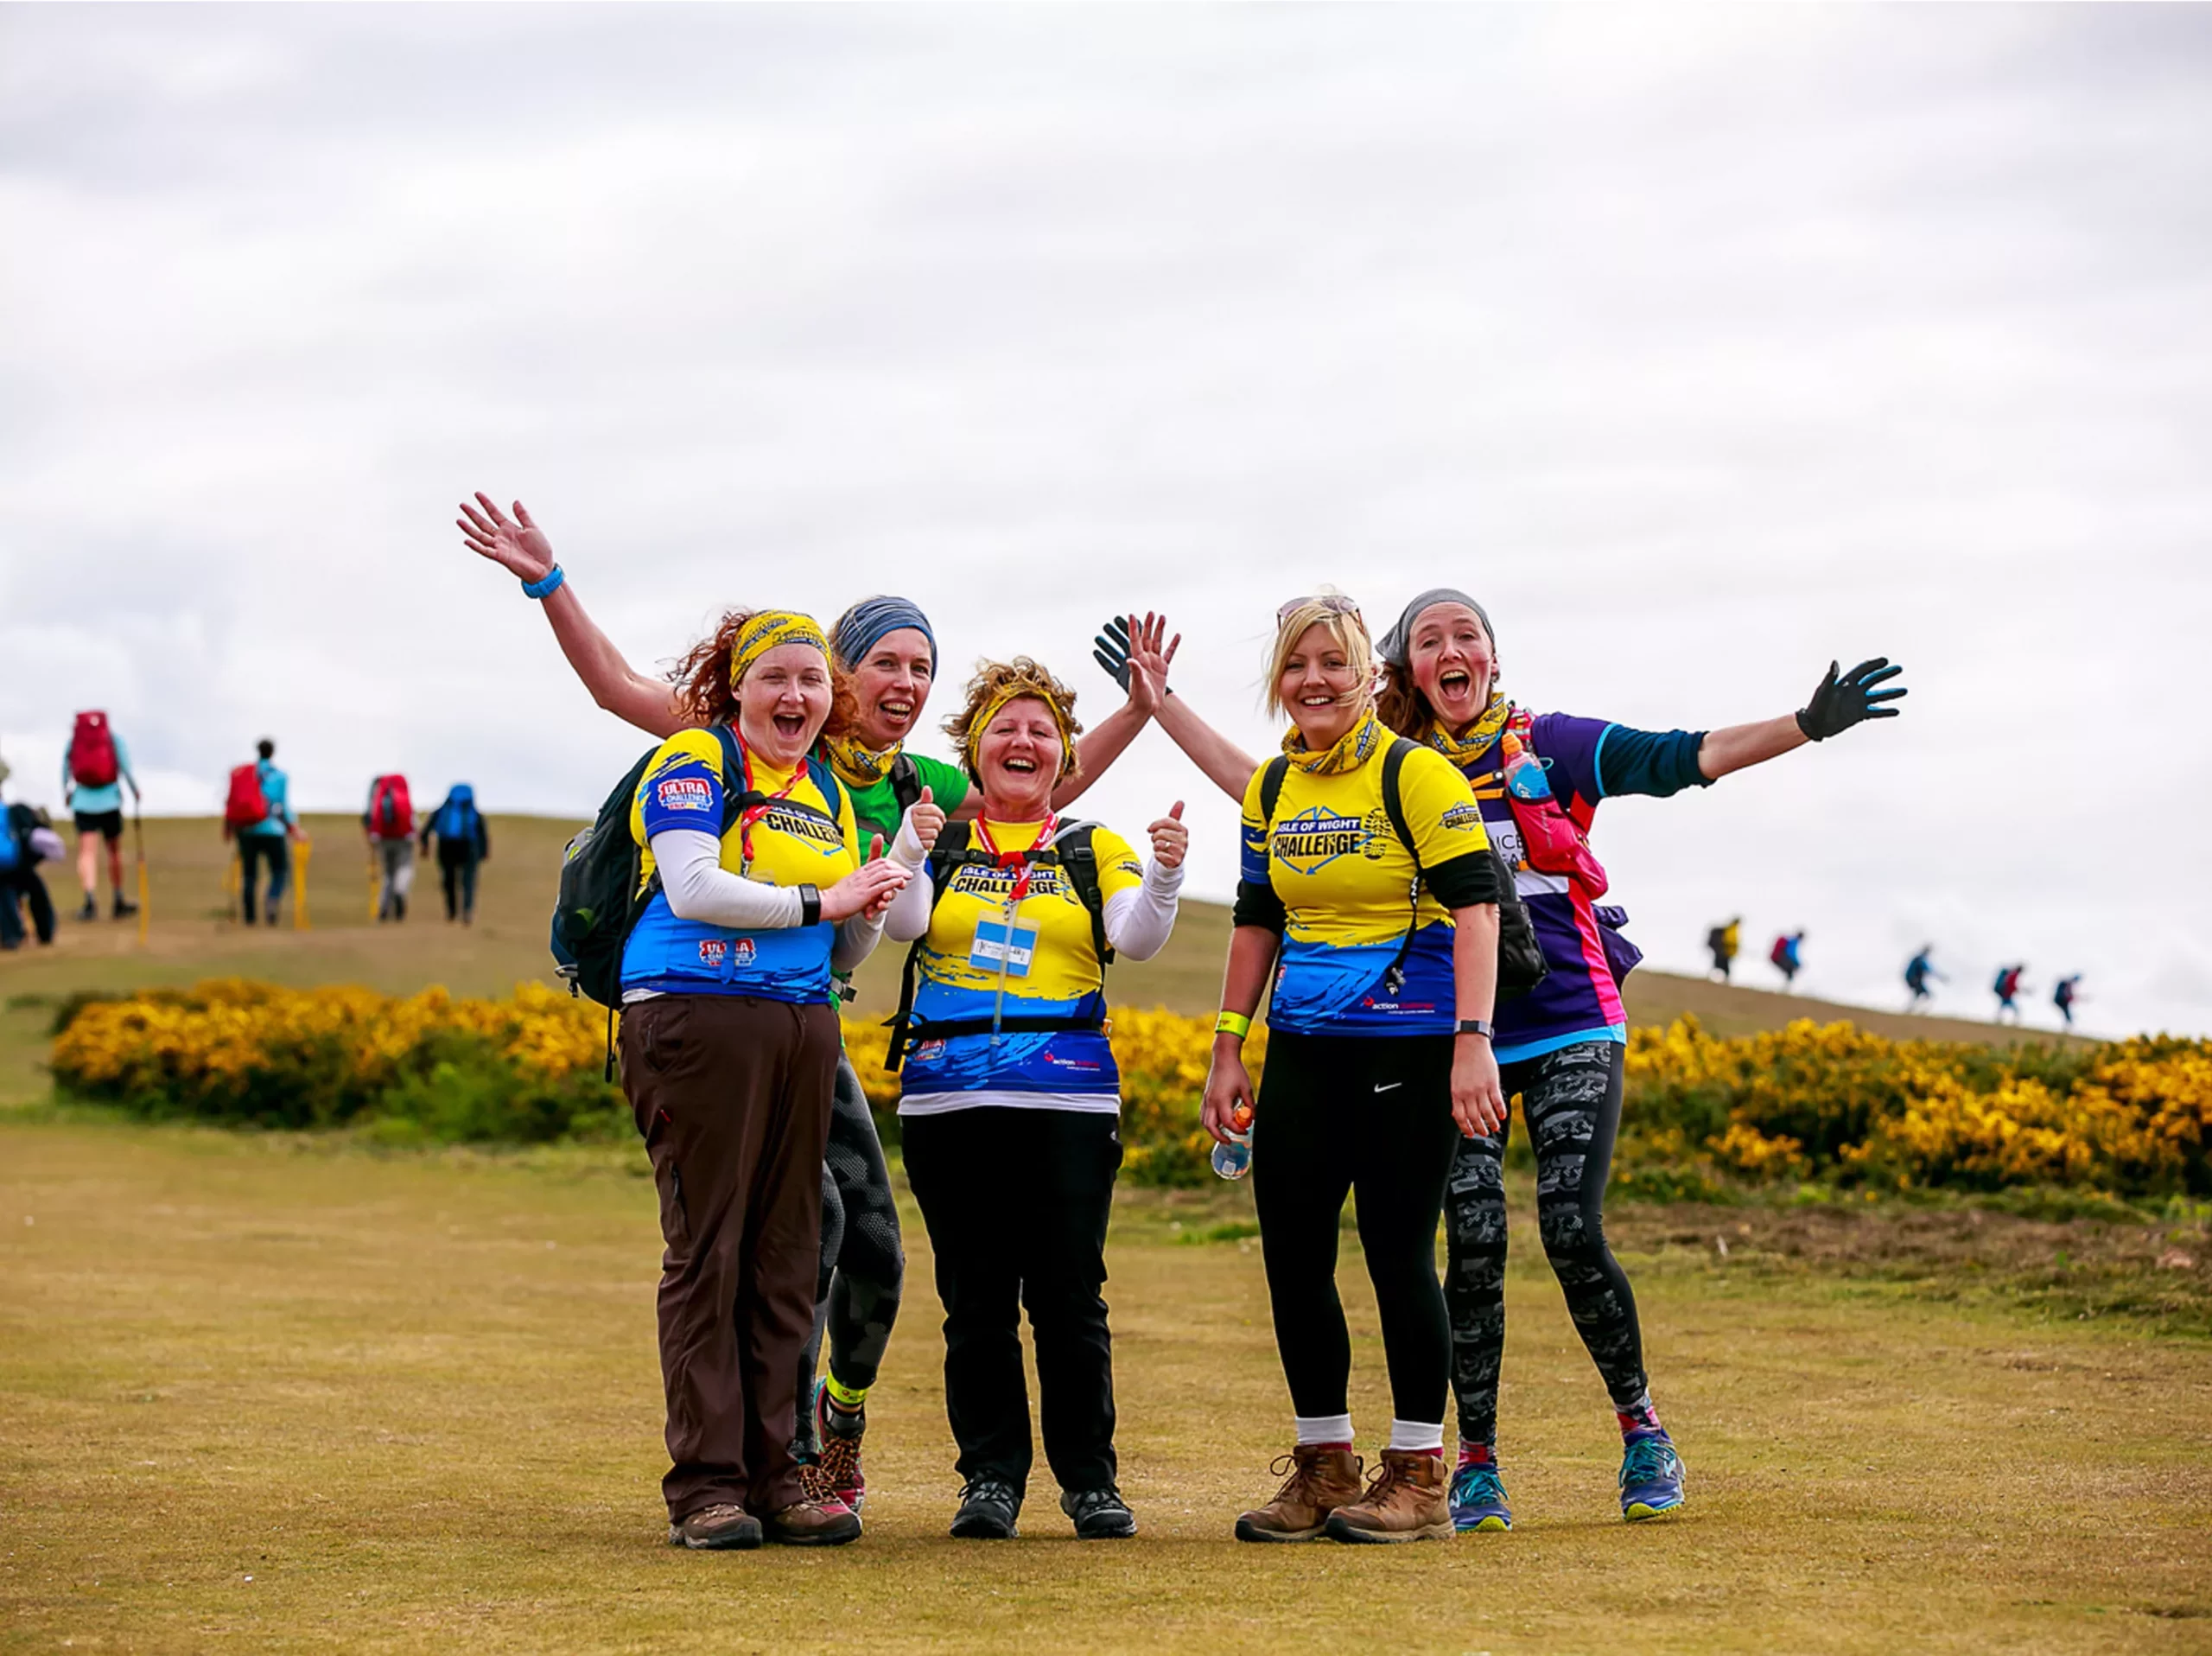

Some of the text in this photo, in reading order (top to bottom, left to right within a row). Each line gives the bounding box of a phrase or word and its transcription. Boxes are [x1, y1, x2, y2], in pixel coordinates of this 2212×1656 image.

[664, 781, 706, 795] ULTRA
[1276, 819, 1360, 833] ISLE OF WIGHT
[1274, 832, 1361, 858] CHALLENGE
[962, 866, 989, 877] ISLE
[1012, 869, 1055, 880] GHT
[954, 877, 1060, 895] CHALLGE
